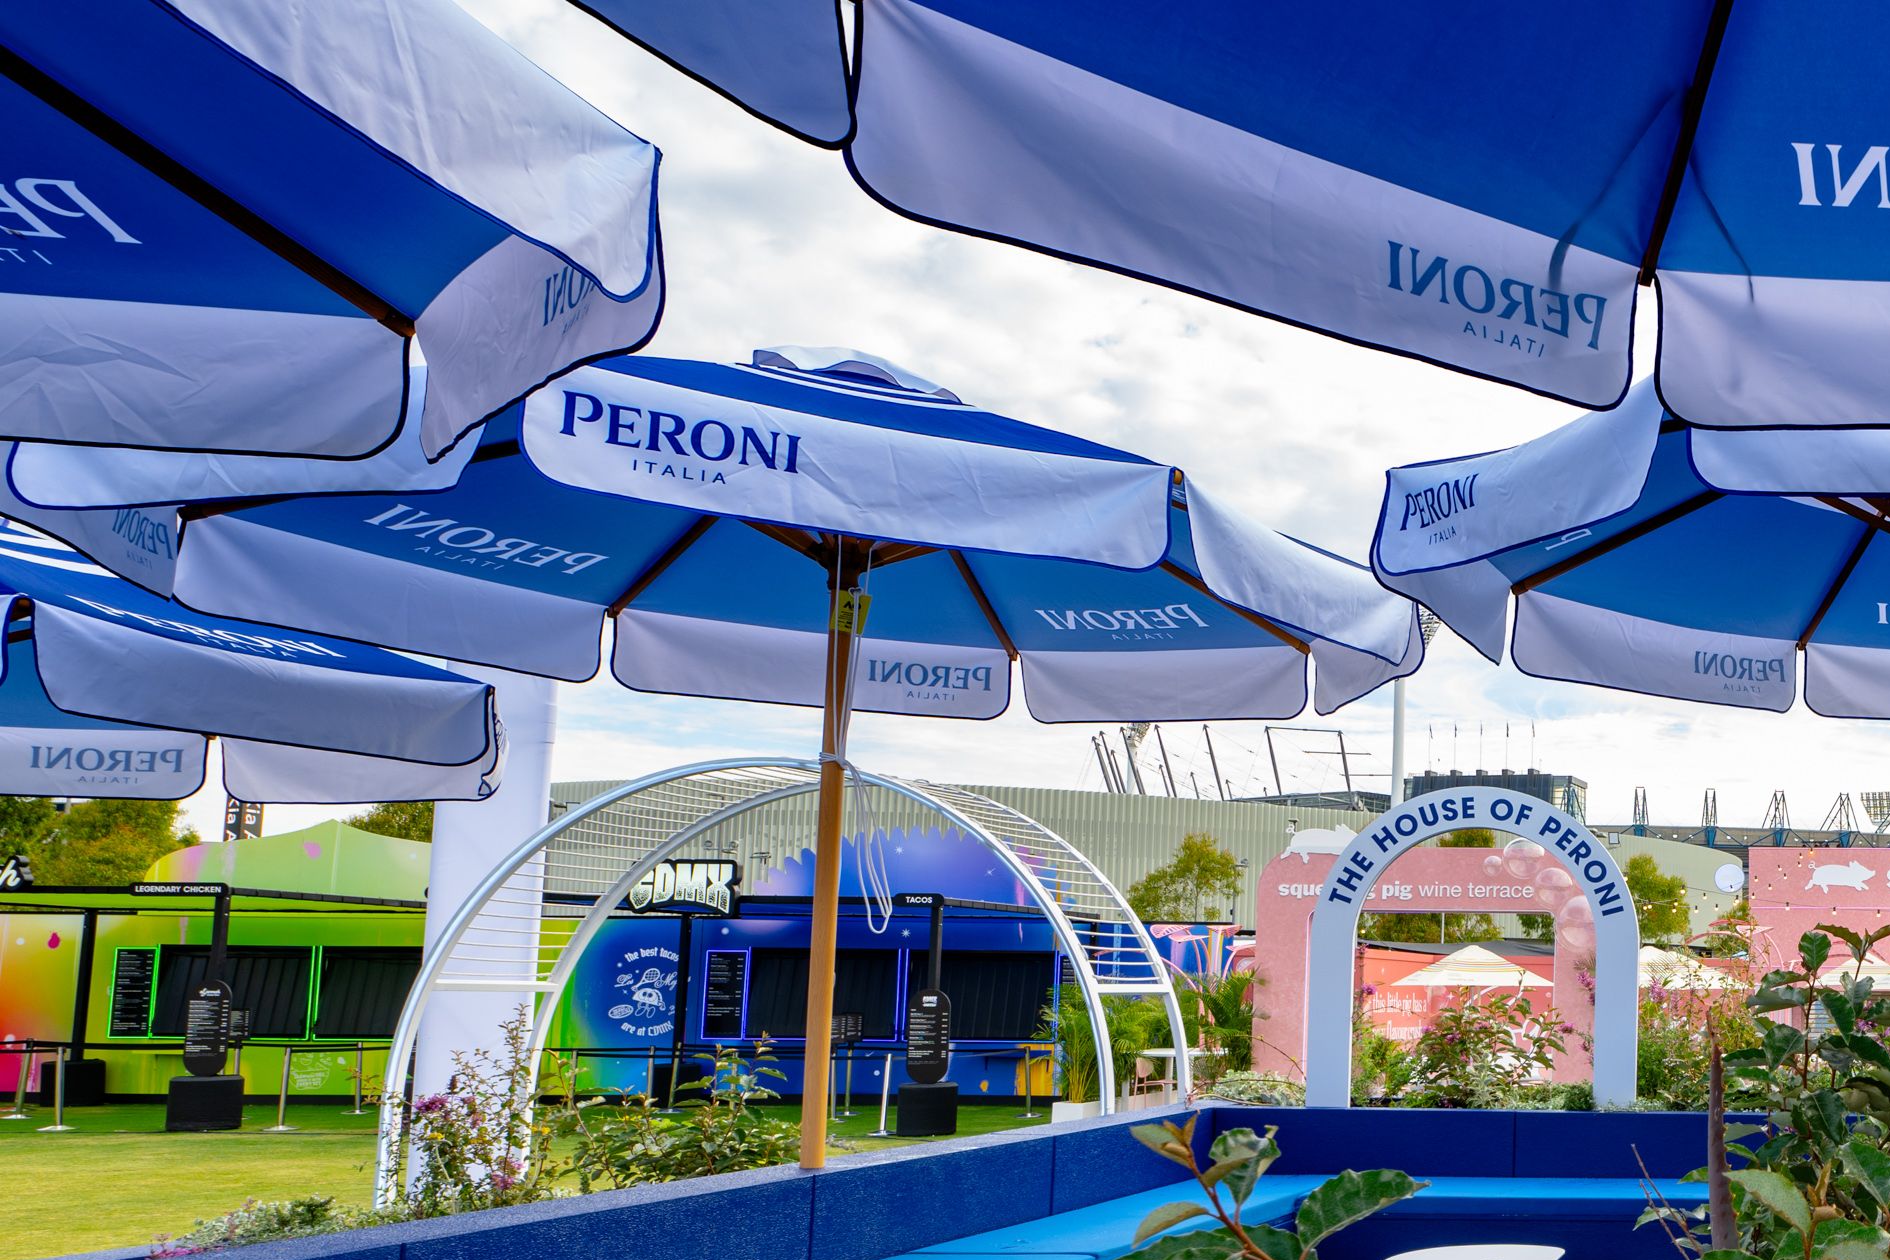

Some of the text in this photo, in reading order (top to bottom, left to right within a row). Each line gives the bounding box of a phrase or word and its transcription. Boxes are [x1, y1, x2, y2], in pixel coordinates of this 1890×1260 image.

[559, 390, 802, 474] PERONI
[632, 459, 726, 485] ITALIA
[1400, 473, 1479, 531] PERONI
[1429, 526, 1457, 545] ITALIA
[1328, 797, 1625, 917] THE HOUSE OF PERONI
[135, 885, 181, 893] LEGENDARY
[905, 896, 933, 904] TACOS
[1382, 880, 1413, 901] pig
[1417, 882, 1462, 898] wine
[1467, 882, 1534, 898] terrace
